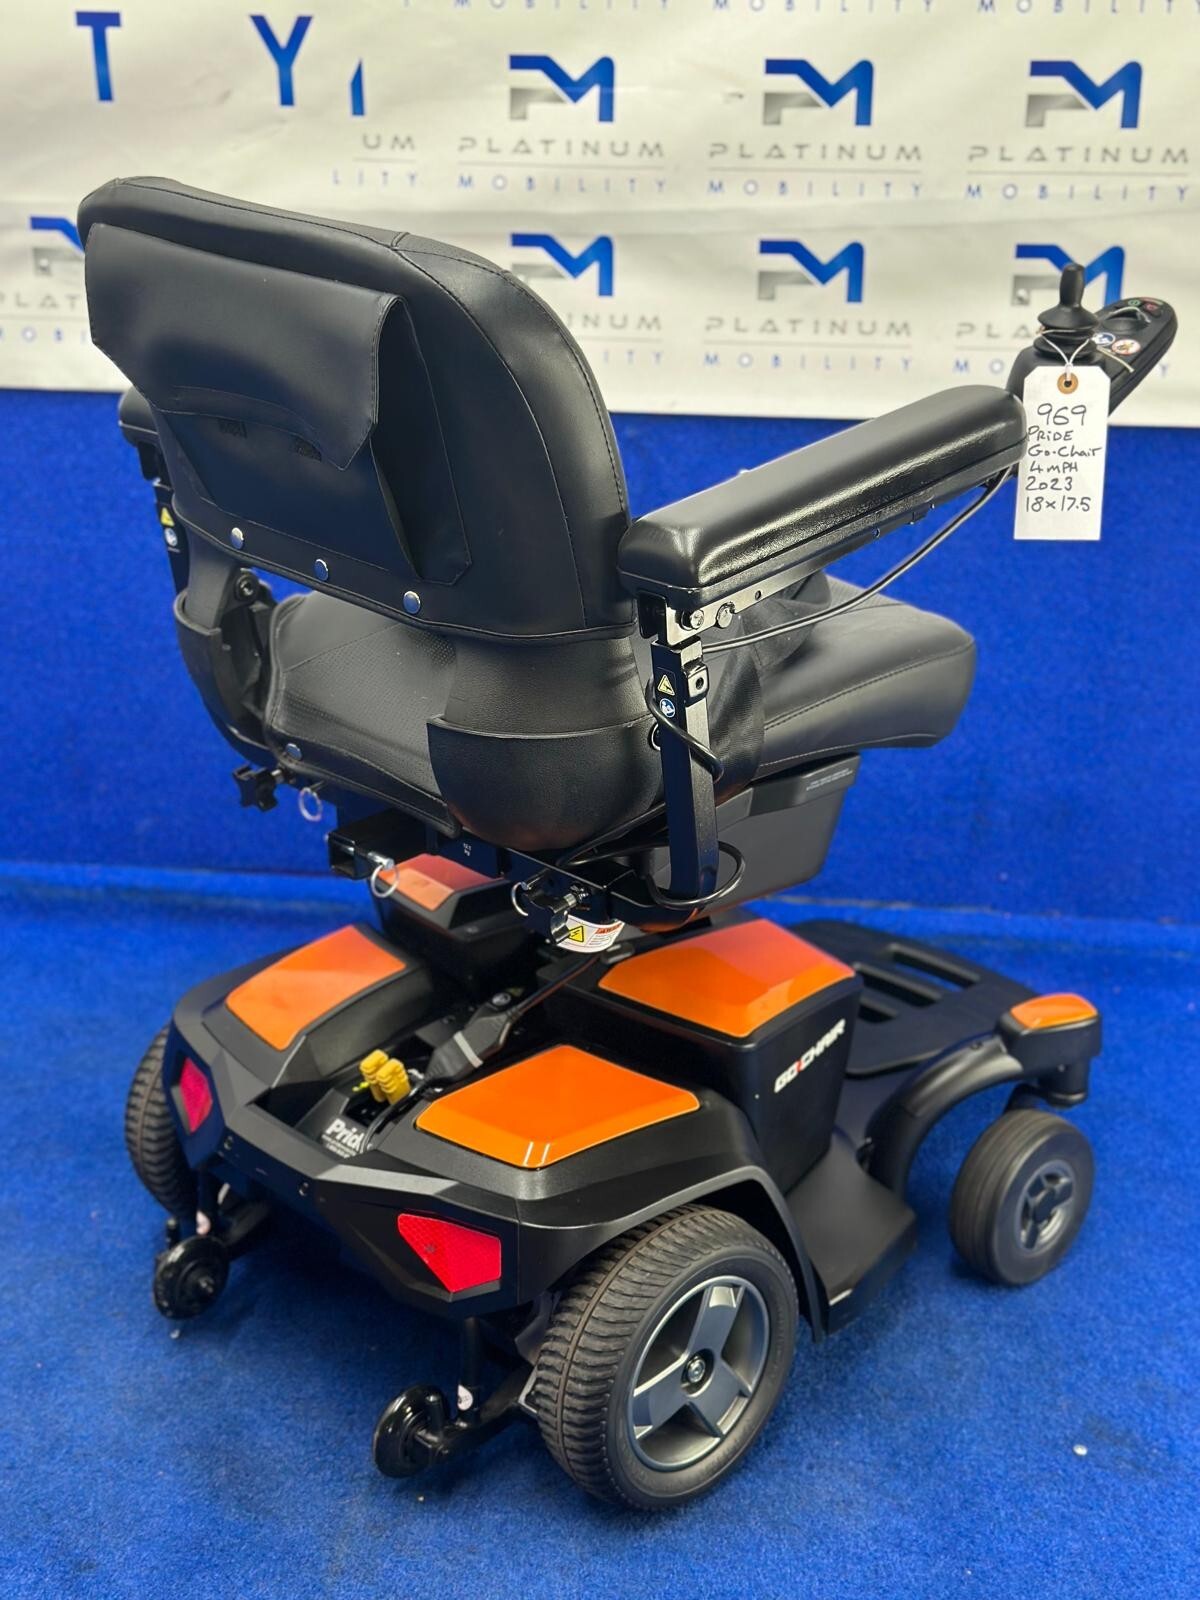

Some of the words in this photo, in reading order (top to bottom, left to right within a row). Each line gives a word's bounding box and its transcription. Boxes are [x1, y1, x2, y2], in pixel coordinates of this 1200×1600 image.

[457, 136, 664, 158] PLATINUM
[709, 143, 922, 161] PLATINUM
[967, 145, 1189, 164] PLATINUM
[457, 175, 667, 193] MOBILITY
[708, 180, 922, 197] MOBILITY
[966, 183, 1189, 202] MOBILITY
[704, 317, 912, 337] PLATINUM
[704, 353, 913, 371] MOBILITY
[1037, 403, 1087, 426] 969
[1025, 475, 1074, 491] 2023
[325, 1118, 364, 1152] Prid
